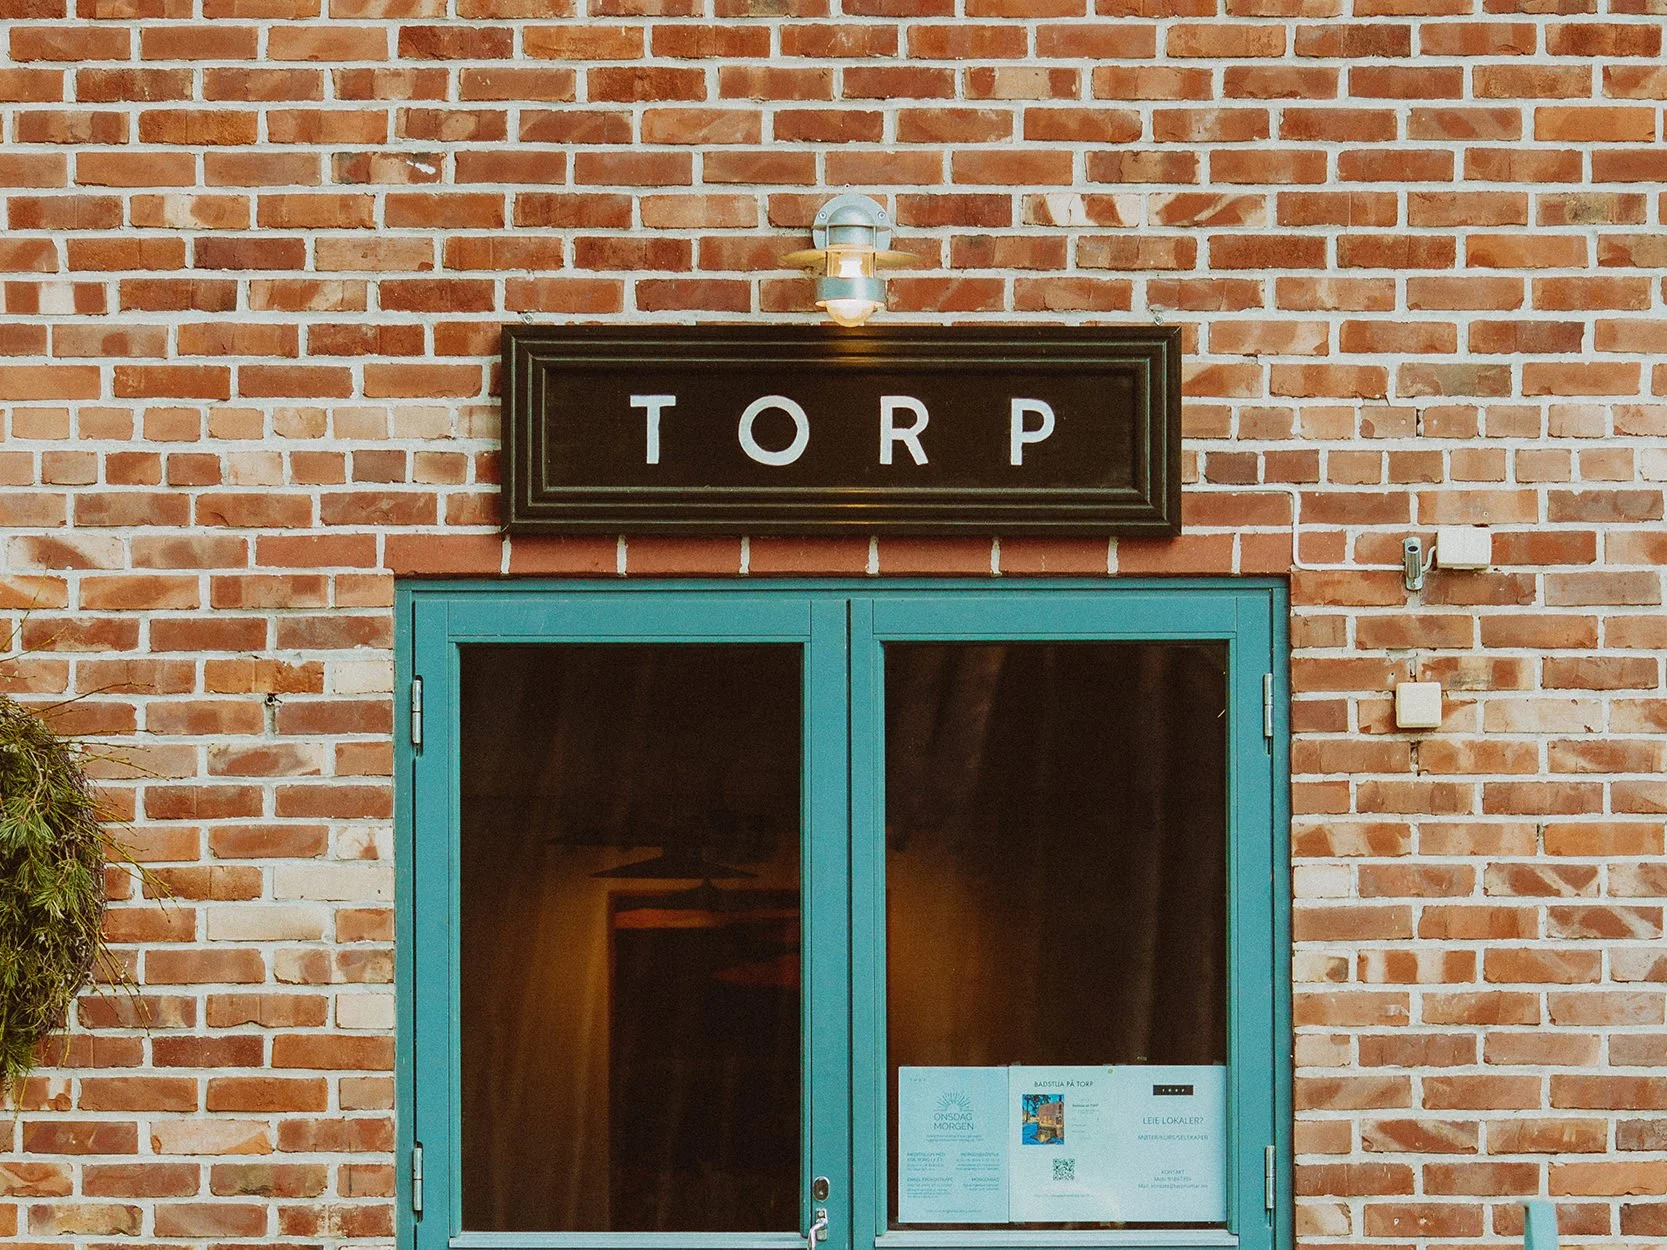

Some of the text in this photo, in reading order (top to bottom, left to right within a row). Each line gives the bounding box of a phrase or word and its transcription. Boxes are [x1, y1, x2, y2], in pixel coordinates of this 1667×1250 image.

[629, 394, 1056, 466] TORP
[1066, 1079, 1075, 1087] PÅ
[933, 1112, 973, 1121] ONSDAG
[1142, 1116, 1204, 1125] LEIE LOKALER?
[933, 1122, 975, 1131] MORGEN
